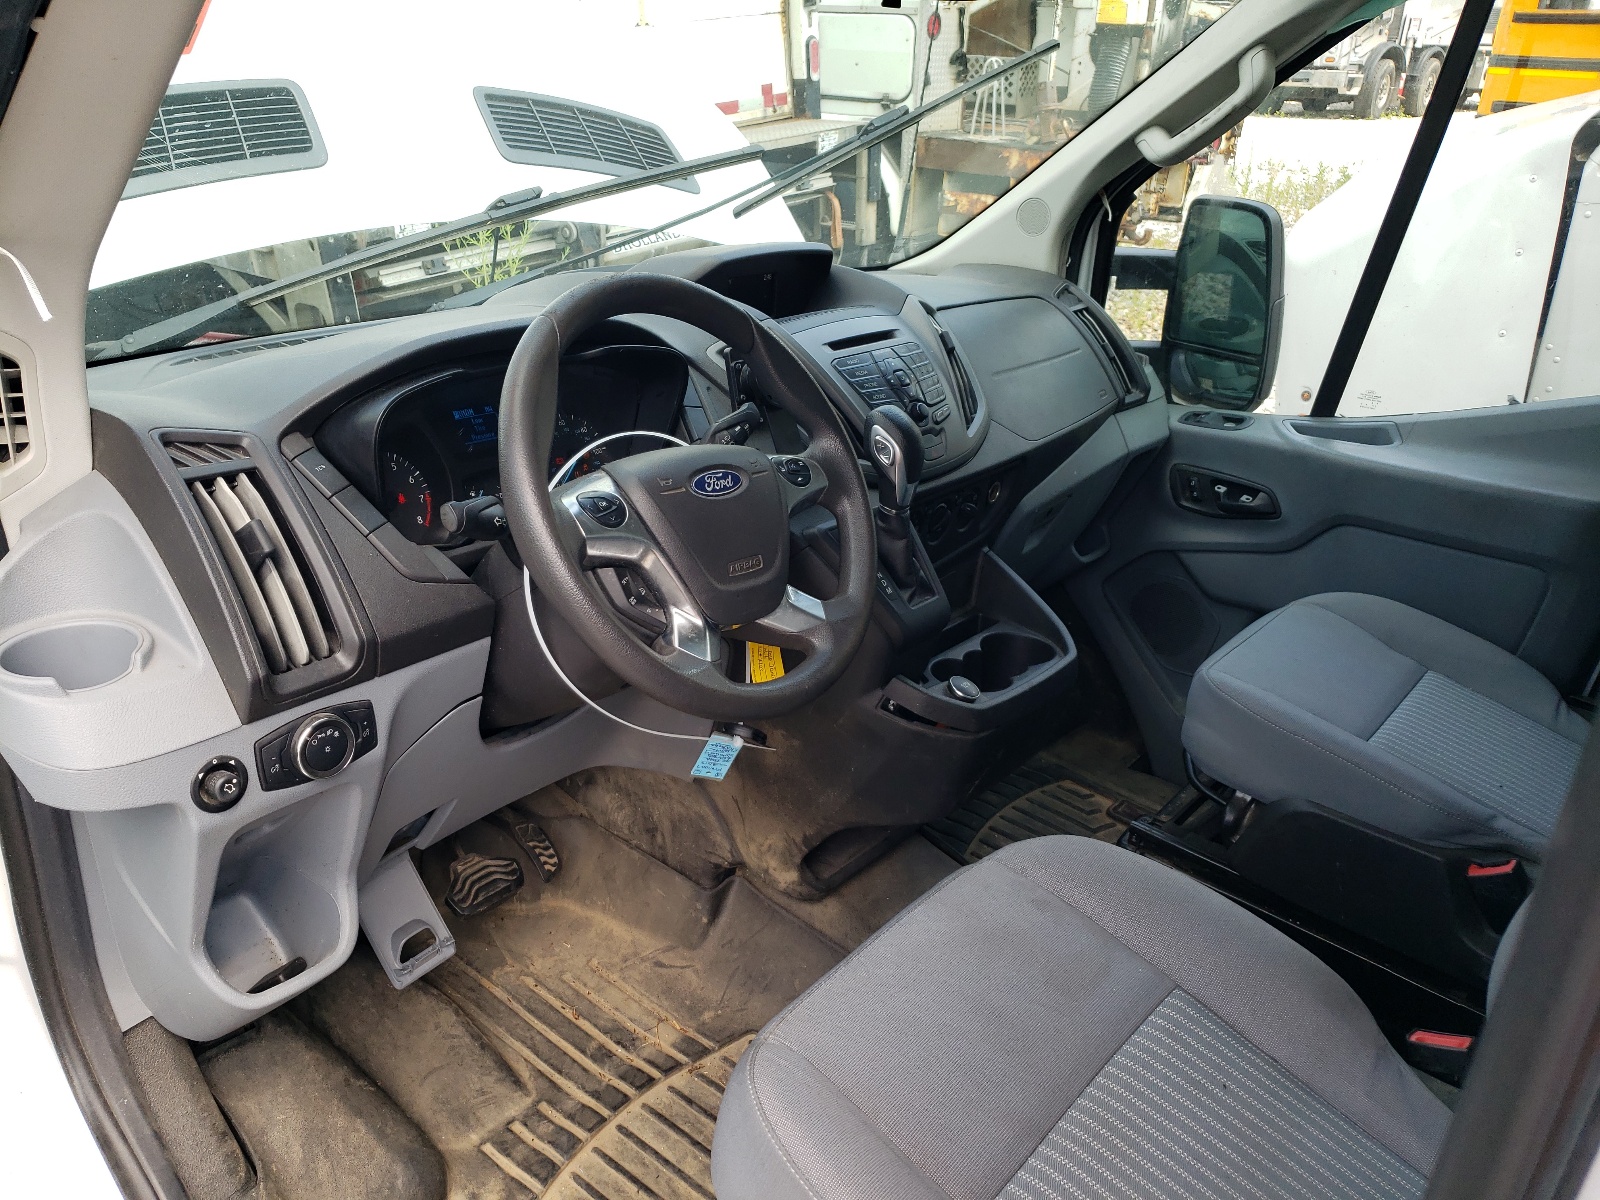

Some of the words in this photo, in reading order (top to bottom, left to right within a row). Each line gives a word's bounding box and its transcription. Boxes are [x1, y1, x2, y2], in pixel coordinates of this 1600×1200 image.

[704, 472, 734, 492] Ford
[416, 515, 424, 524] 8
[730, 557, 762, 574] AIRBAG
